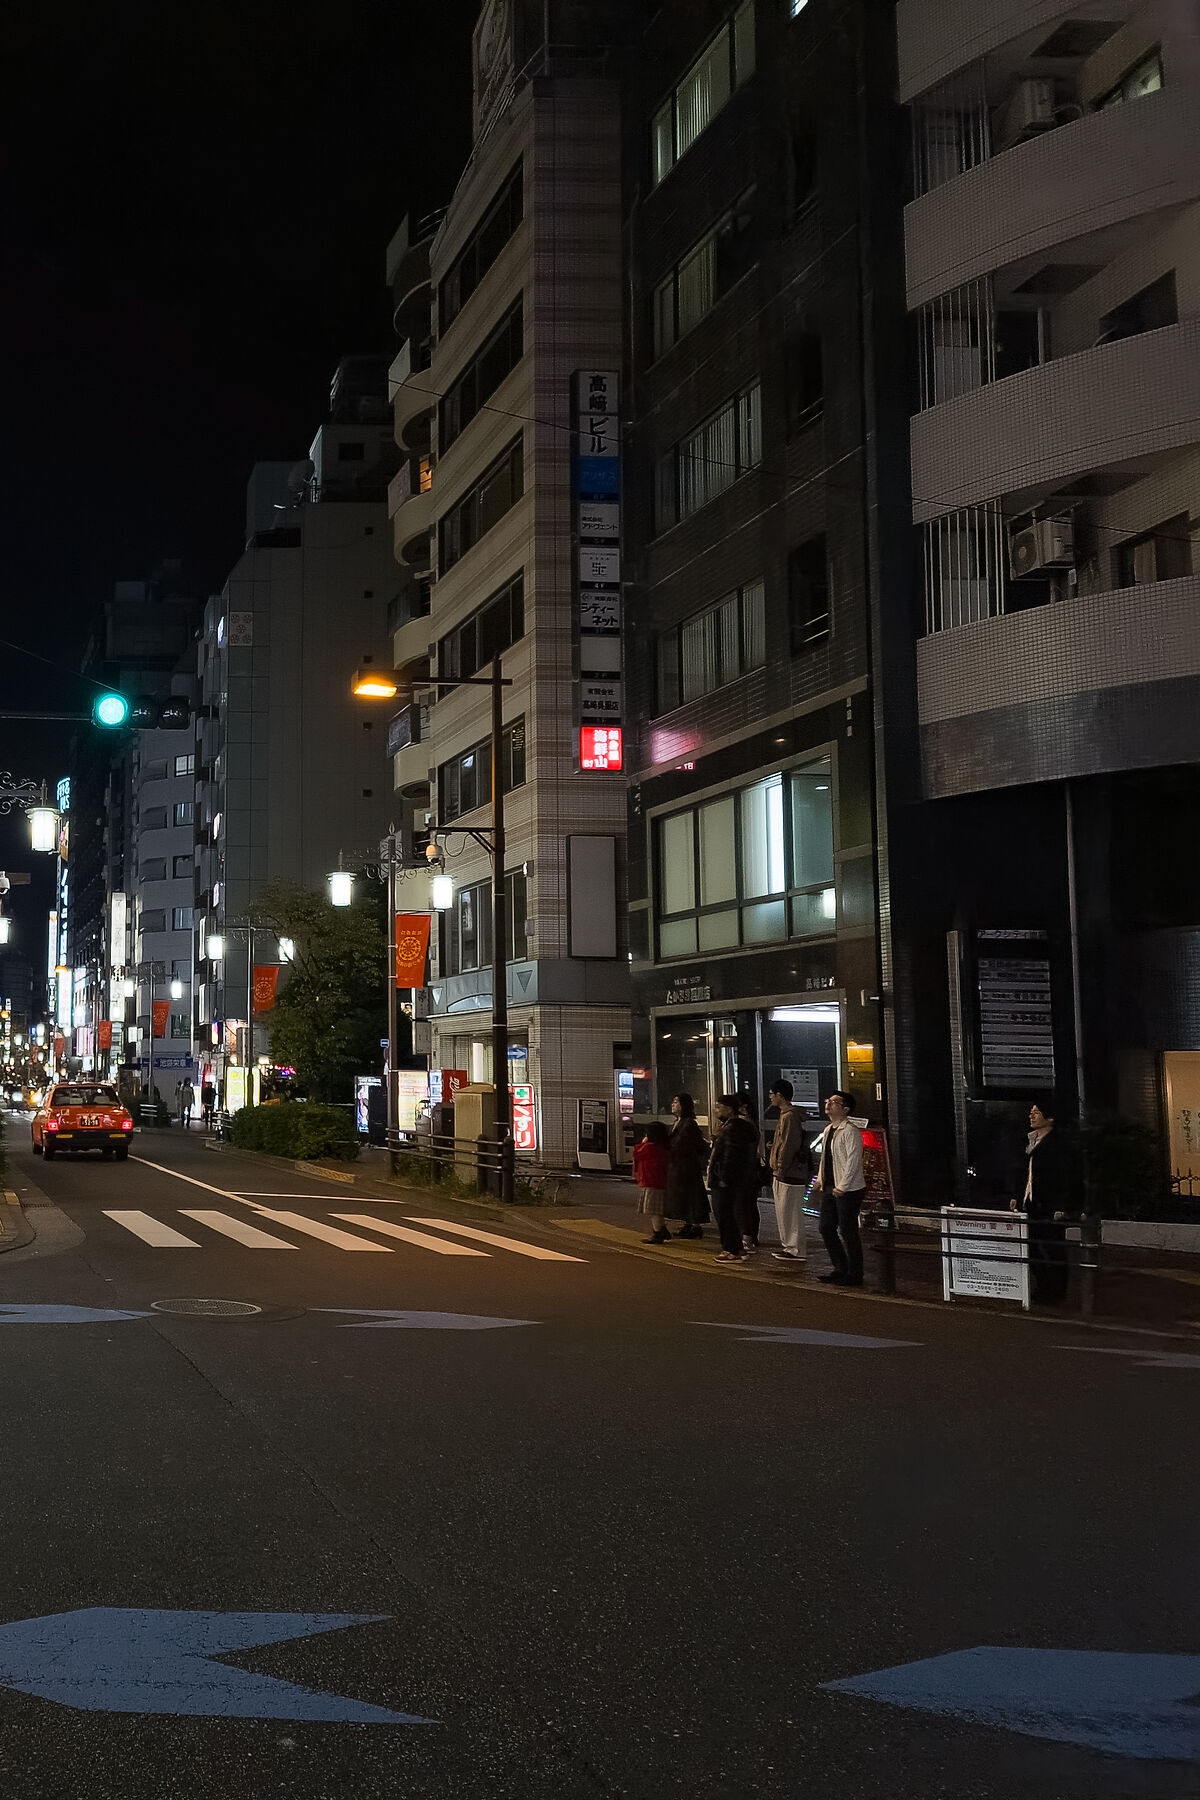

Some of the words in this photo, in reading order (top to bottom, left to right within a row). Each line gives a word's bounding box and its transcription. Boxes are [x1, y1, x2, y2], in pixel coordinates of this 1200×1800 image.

[513, 1099, 533, 1148] くすり
[955, 1220, 987, 1230] Warning
